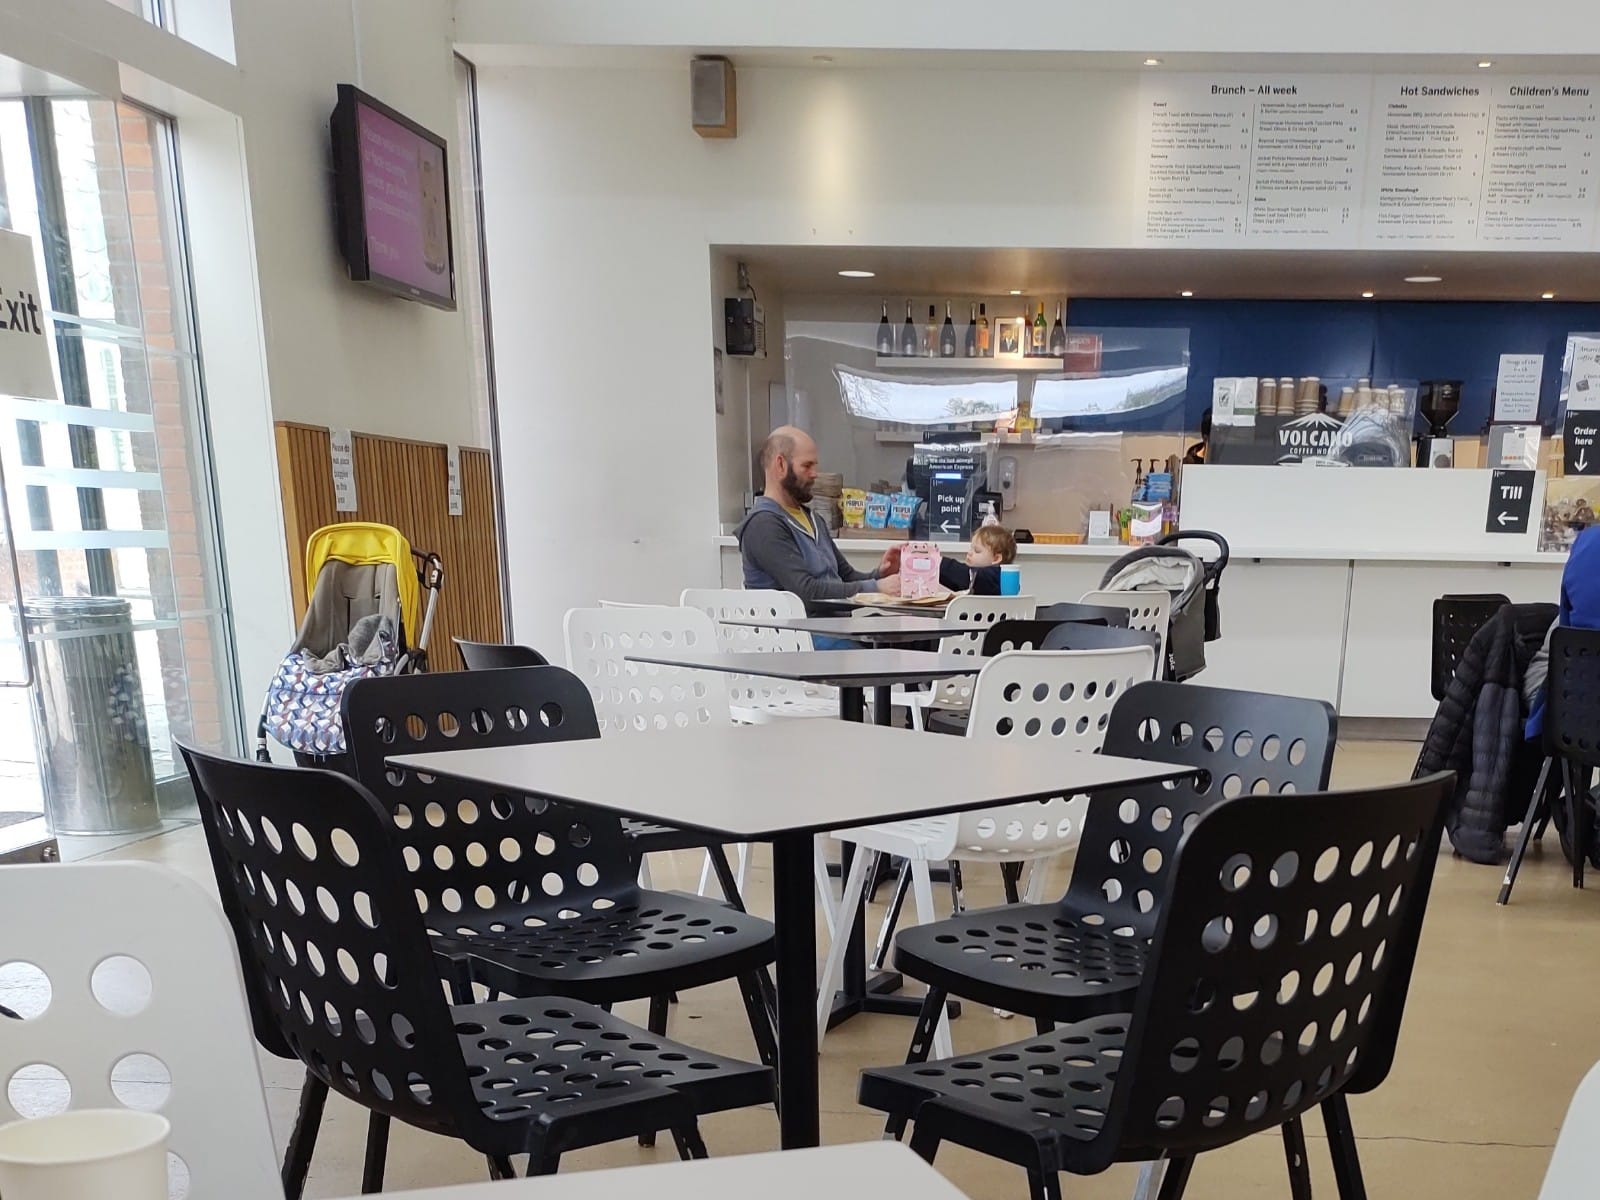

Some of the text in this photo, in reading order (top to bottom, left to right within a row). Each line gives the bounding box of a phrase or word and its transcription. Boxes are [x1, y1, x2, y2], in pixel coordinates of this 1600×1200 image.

[1211, 84, 1246, 96] Brunch
[1257, 84, 1270, 96] All
[1272, 84, 1298, 96] week
[1400, 86, 1480, 98] Hot Sandwiches
[1509, 86, 1591, 98] Children's Menu
[1573, 426, 1598, 437] Order
[1279, 429, 1353, 448] VOLCANO
[1574, 436, 1594, 446] here
[1289, 447, 1314, 456] COFFEE
[1500, 485, 1523, 500] Till
[937, 494, 965, 505] Pick up
[941, 505, 961, 514] point
